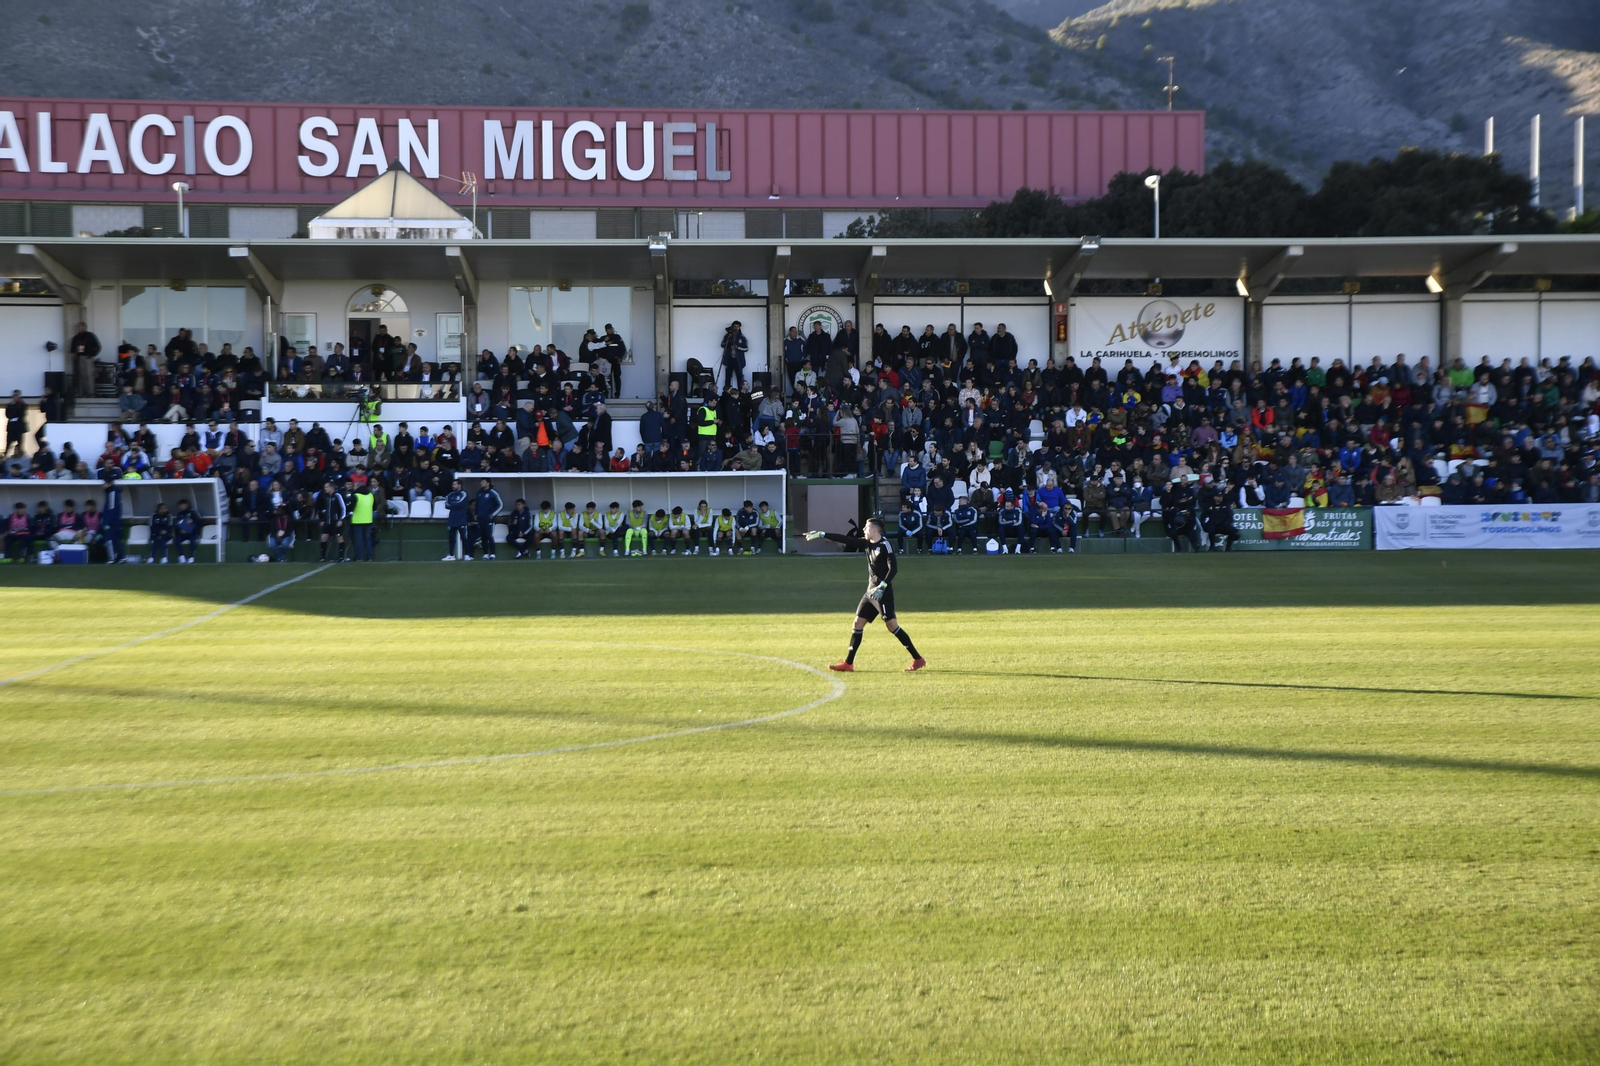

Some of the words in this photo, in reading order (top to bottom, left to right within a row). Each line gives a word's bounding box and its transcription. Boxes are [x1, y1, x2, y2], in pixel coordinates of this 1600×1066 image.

[297, 116, 440, 178] SAN
[483, 119, 731, 181] MIGUEL
[1105, 302, 1216, 346] Atrévete
[1233, 513, 1258, 521] OTEL
[1324, 512, 1357, 520] FRUTAS
[1233, 522, 1264, 530] ESPAD
[1295, 527, 1362, 541] anantiales
